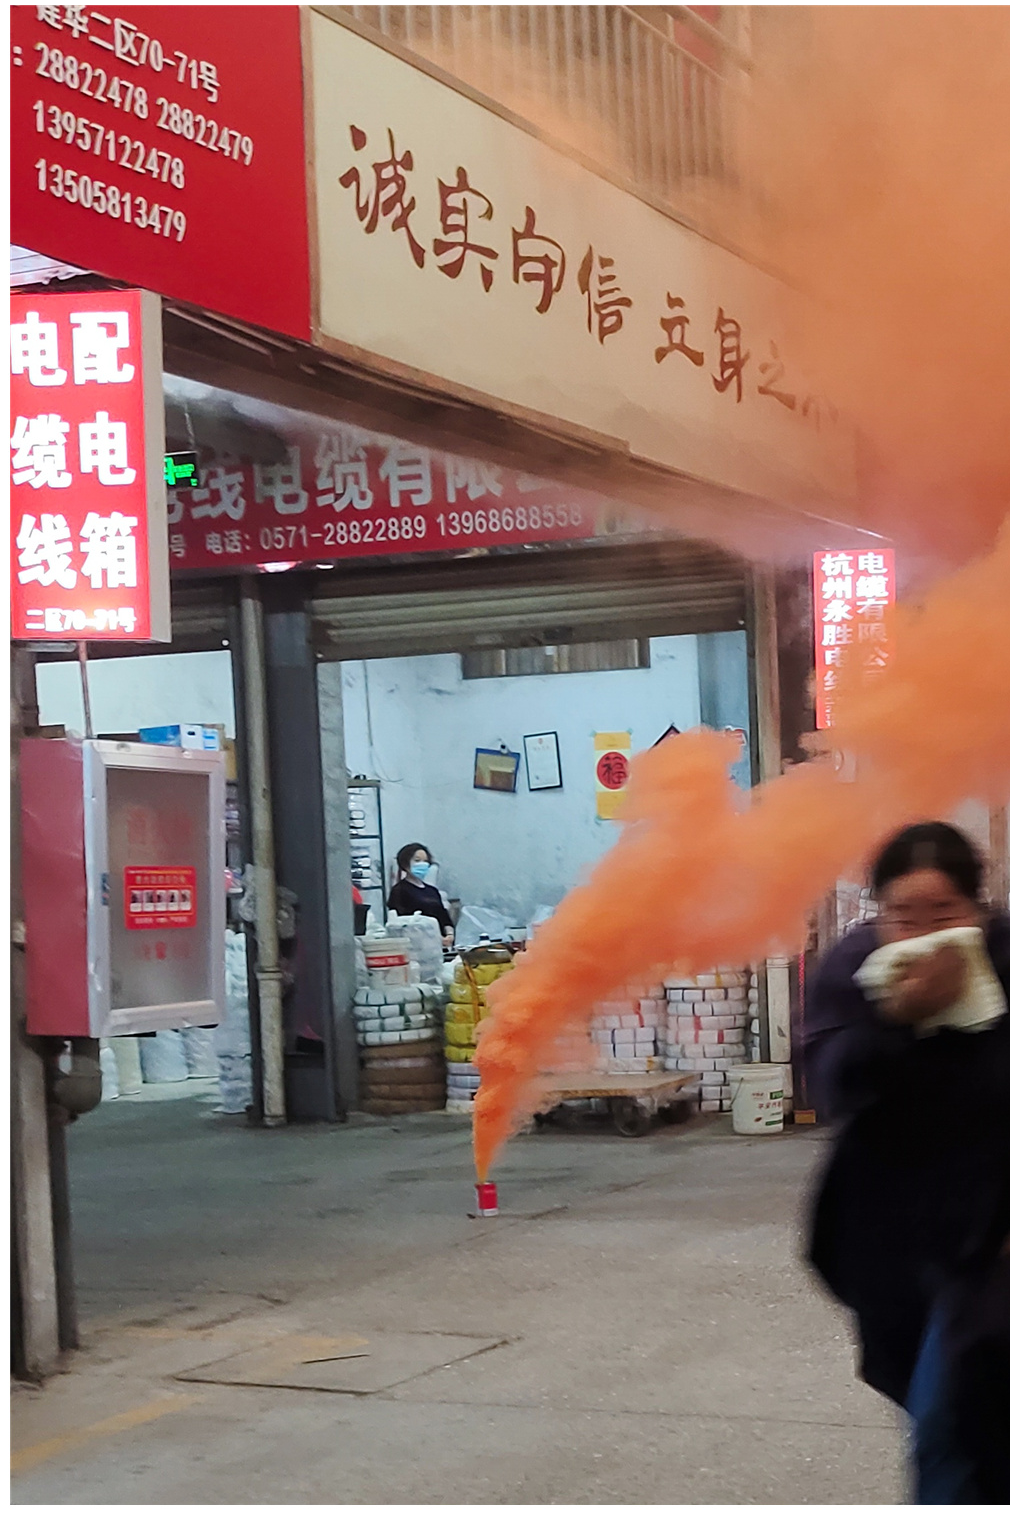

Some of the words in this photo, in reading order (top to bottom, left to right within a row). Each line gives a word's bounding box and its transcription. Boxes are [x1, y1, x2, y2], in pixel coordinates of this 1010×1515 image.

[33, 99, 185, 189] 13957122478
[156, 97, 254, 166] 28822479
[34, 158, 187, 242] 13505813479
[436, 504, 583, 538] 13968688558
[601, 755, 627, 785] 福
